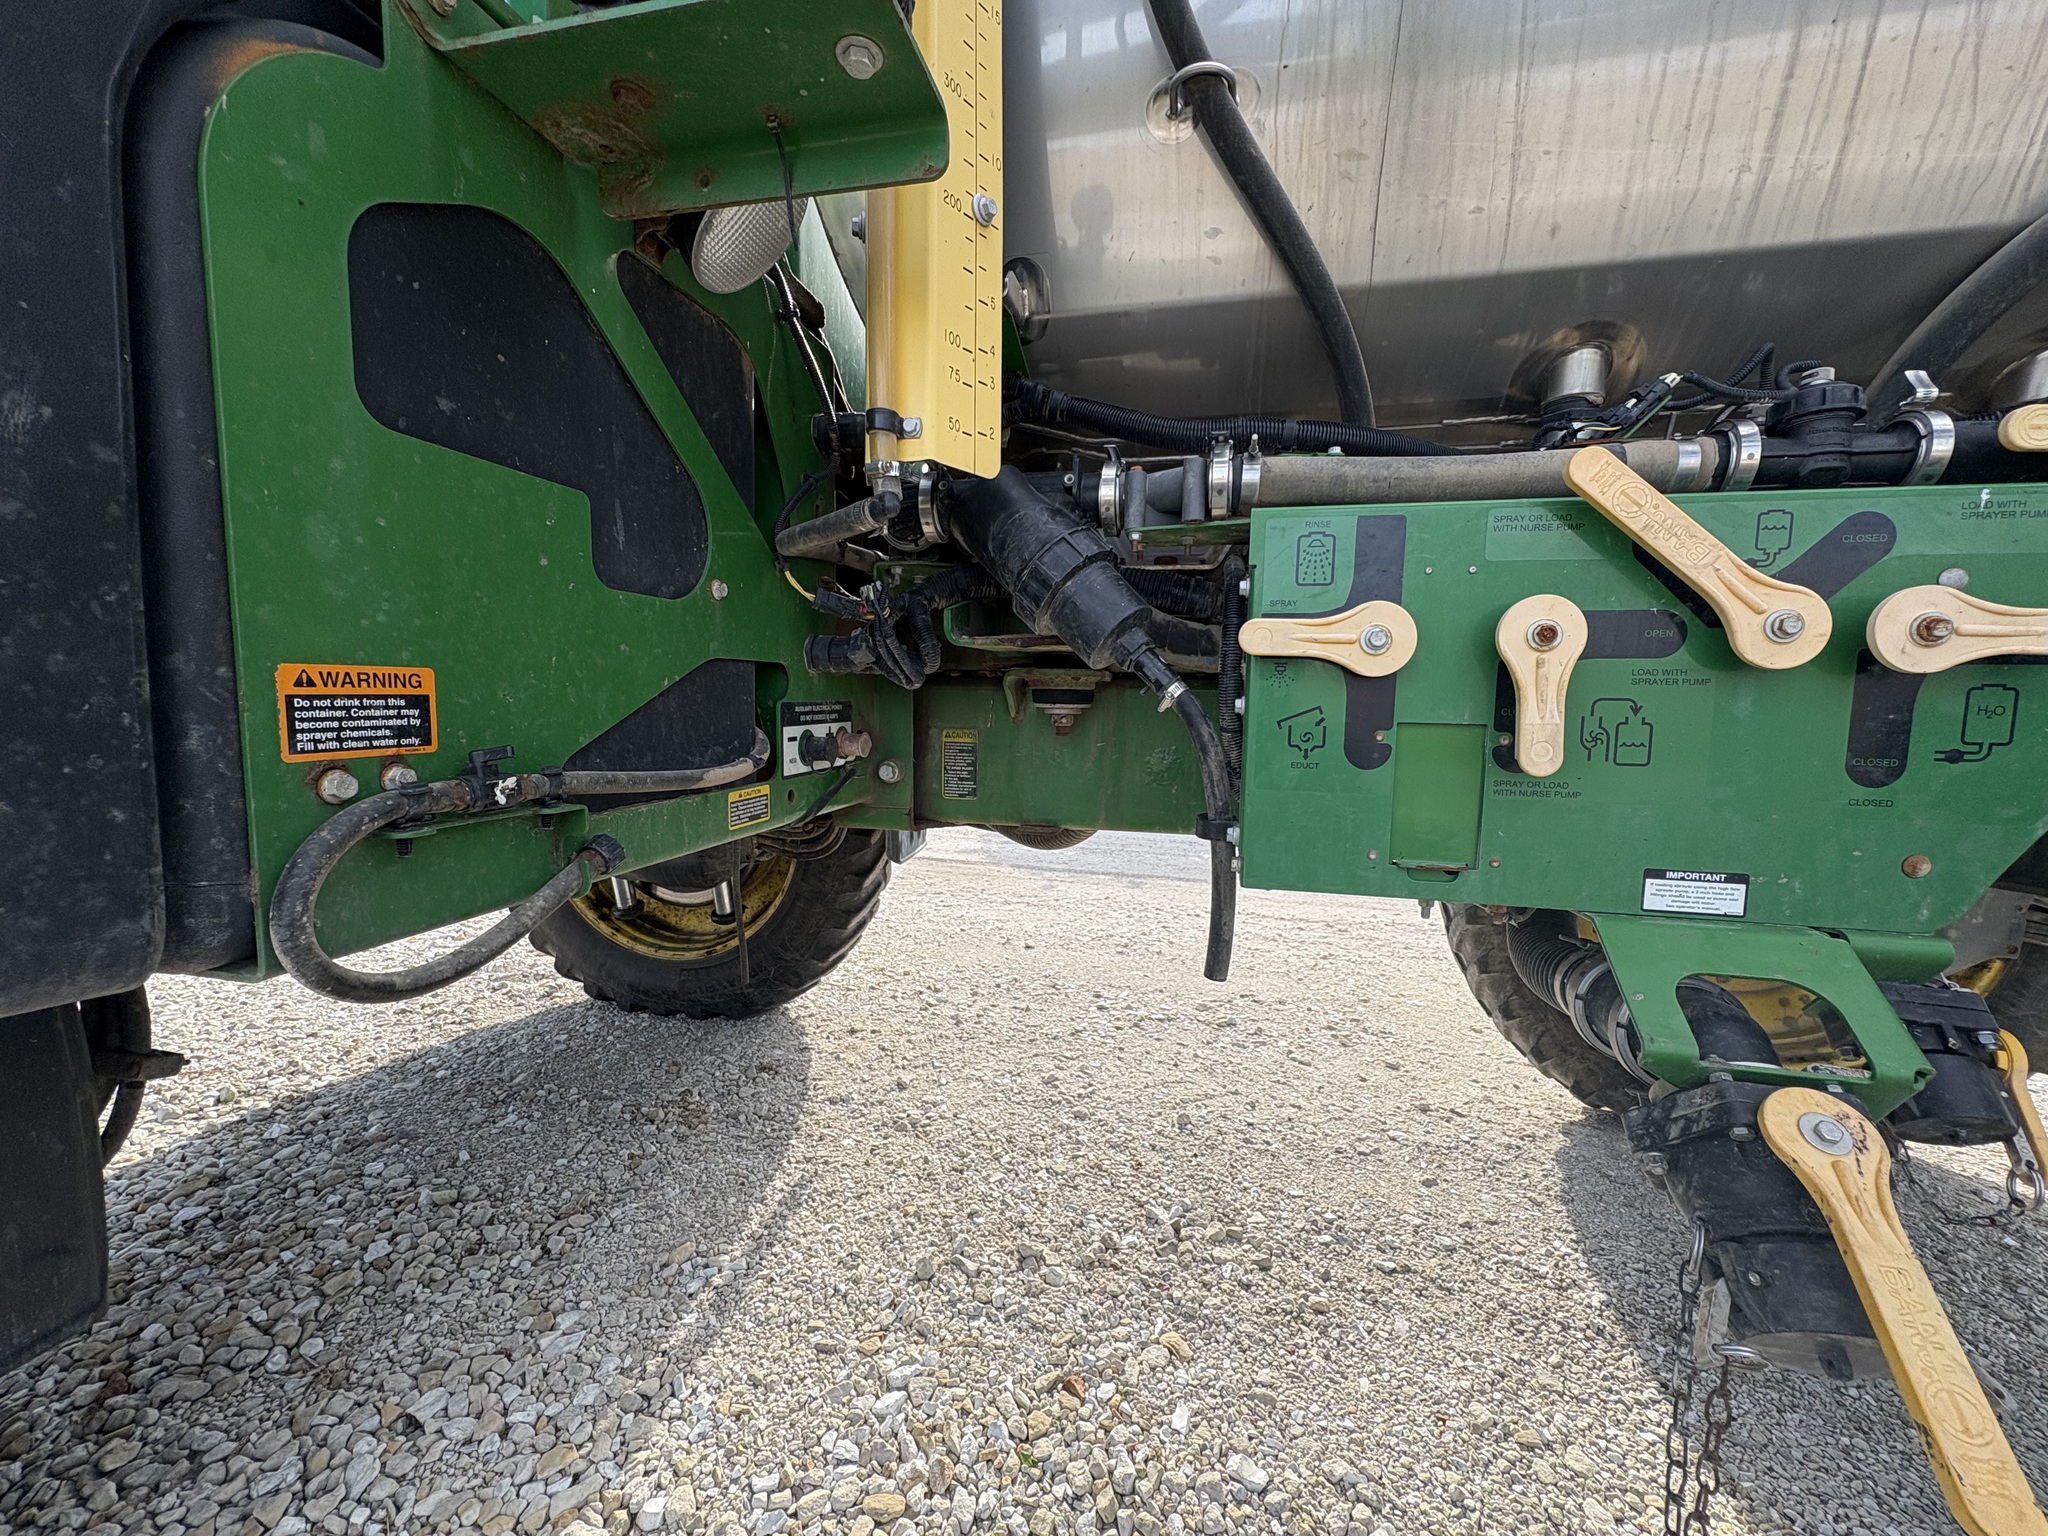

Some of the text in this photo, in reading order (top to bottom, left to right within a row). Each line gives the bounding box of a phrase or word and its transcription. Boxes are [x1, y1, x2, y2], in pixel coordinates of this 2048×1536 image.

[991, 5, 1000, 25] 15
[944, 72, 962, 98] 300
[992, 154, 1001, 172] 10
[944, 189, 962, 212] 200
[990, 297, 996, 310] 5
[944, 328, 961, 348] 100
[990, 345, 995, 358] 4
[948, 365, 961, 383] 75
[990, 376, 995, 390] 3
[948, 416, 961, 432] 50
[989, 427, 995, 440] 2
[1997, 500, 2027, 508] WITH
[1493, 514, 1572, 523] SPRAY OR LOAD
[1960, 510, 2048, 520] SPRAYER PUM
[1842, 534, 1887, 542] CLOSED
[318, 671, 422, 689] WARNING
[294, 698, 406, 707] Do not drink from this
[294, 708, 420, 719] container. Container may
[295, 718, 421, 730] become contaminated by
[296, 728, 393, 742] sprayer chemicals.
[297, 737, 422, 751] Fill with clean water only.
[1853, 758, 1899, 766] CLOSED
[1543, 781, 1569, 790] LOAD
[743, 789, 762, 797] CAUTION
[1519, 790, 1551, 798] NURSE
[1848, 798, 1893, 807] CLOSED
[1666, 871, 1727, 882] IMPORTANT
